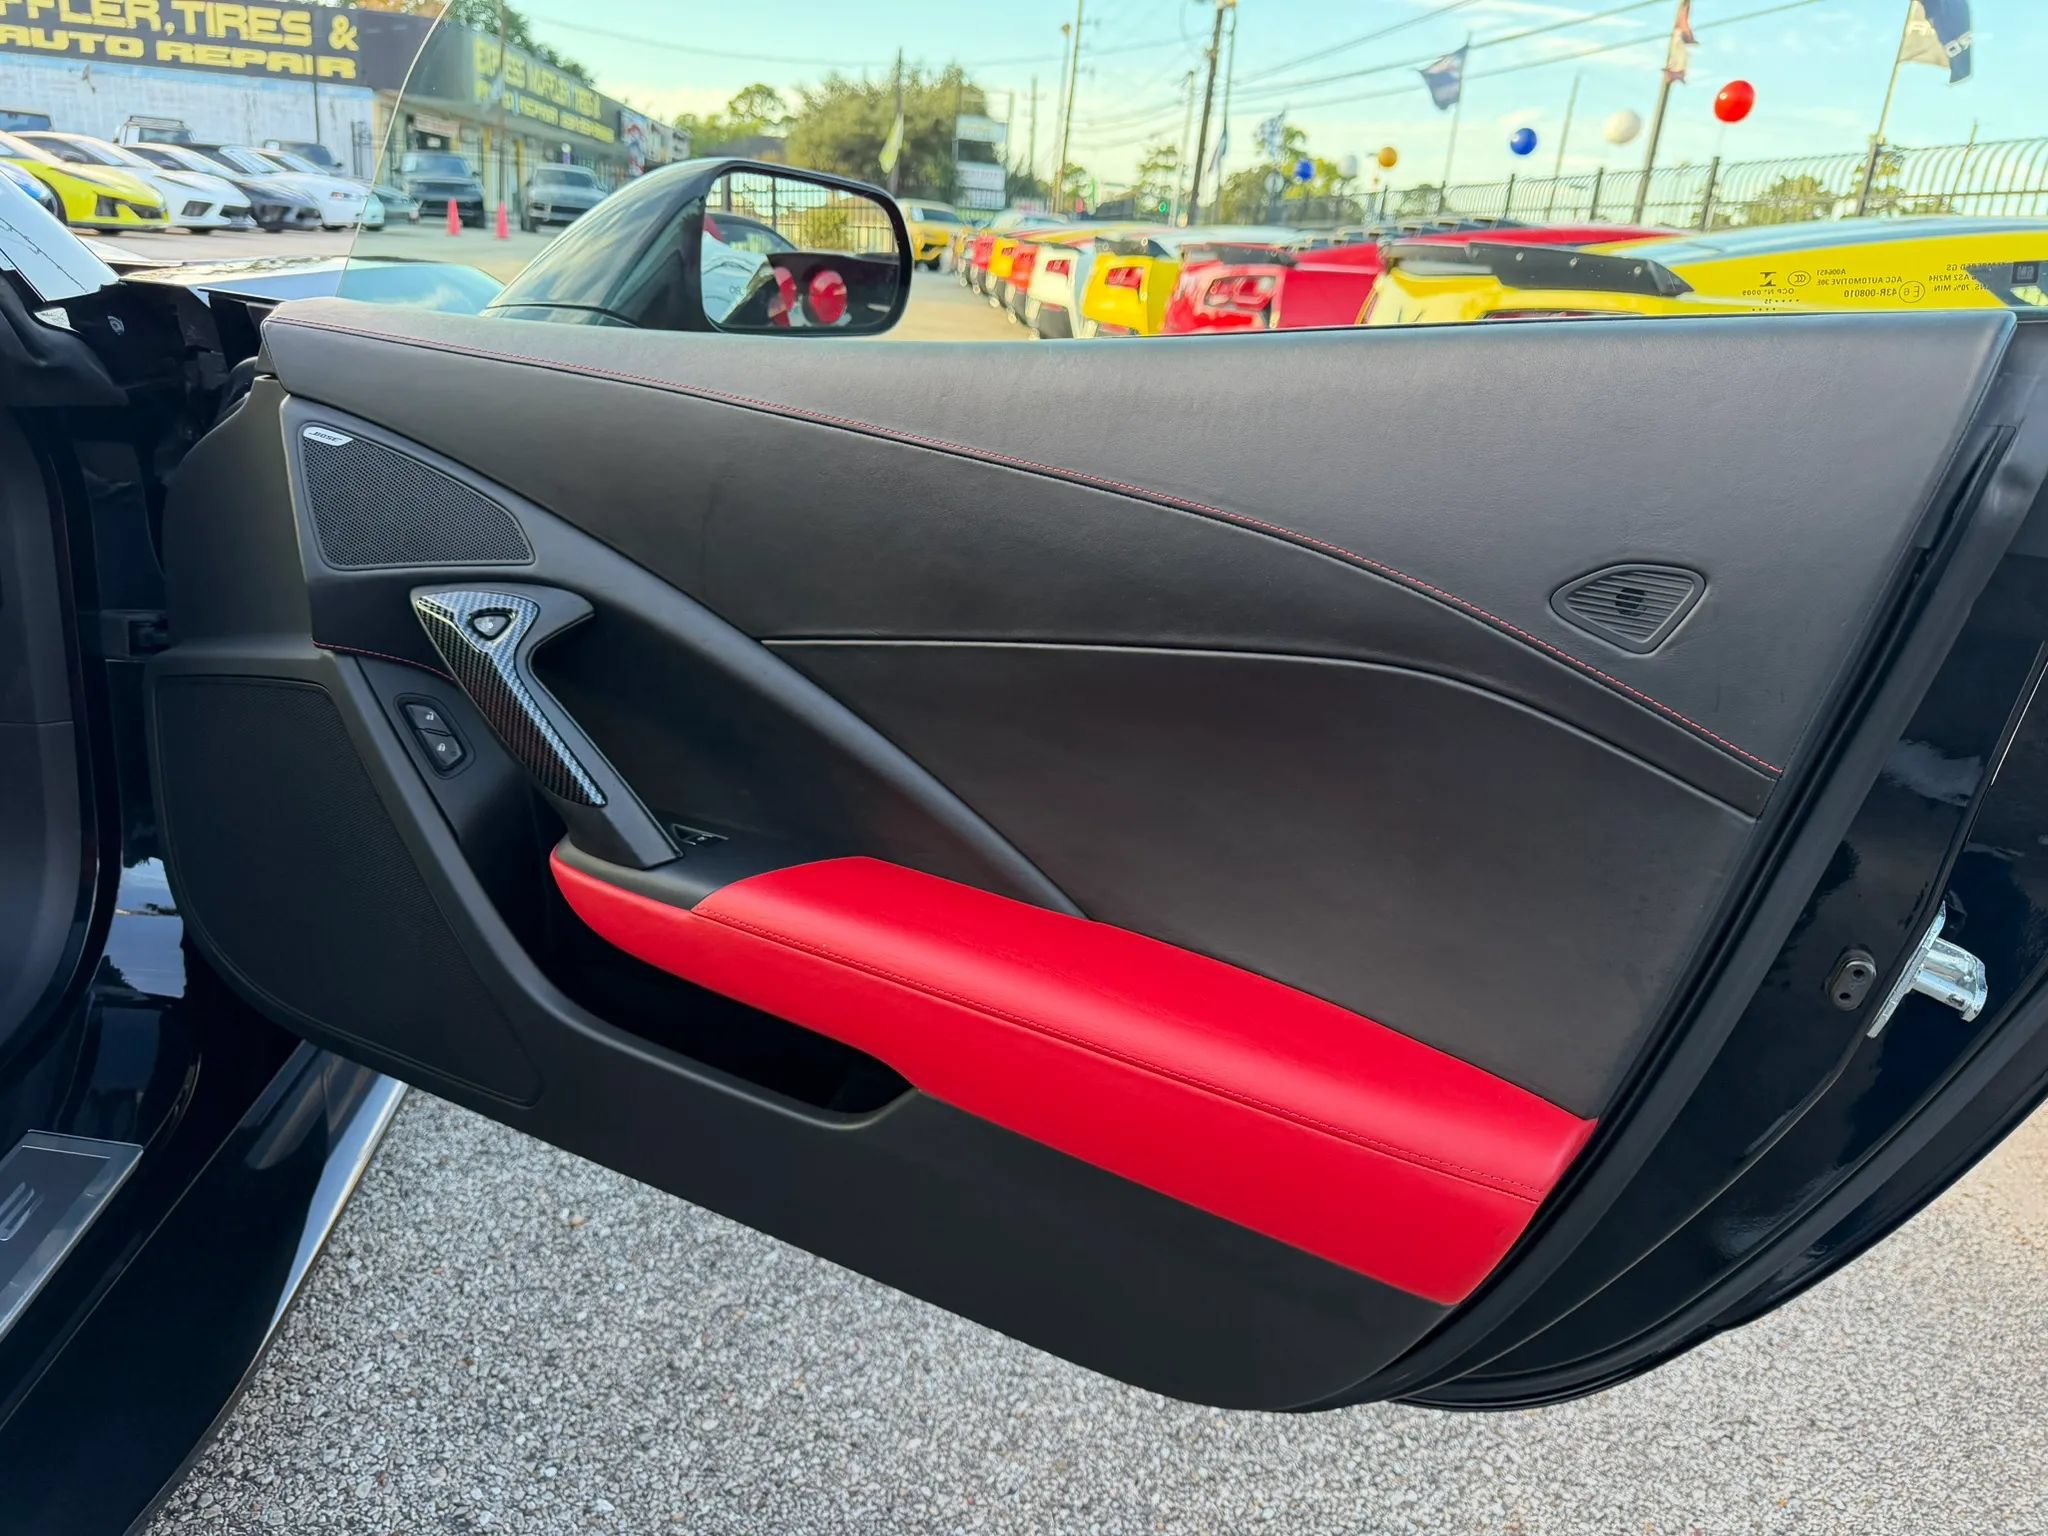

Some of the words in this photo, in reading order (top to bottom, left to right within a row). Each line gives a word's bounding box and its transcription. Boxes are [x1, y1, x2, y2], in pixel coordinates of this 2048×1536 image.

[0, 24, 145, 58] AUTO
[156, 40, 356, 79] REPAIR
[328, 14, 360, 51] &
